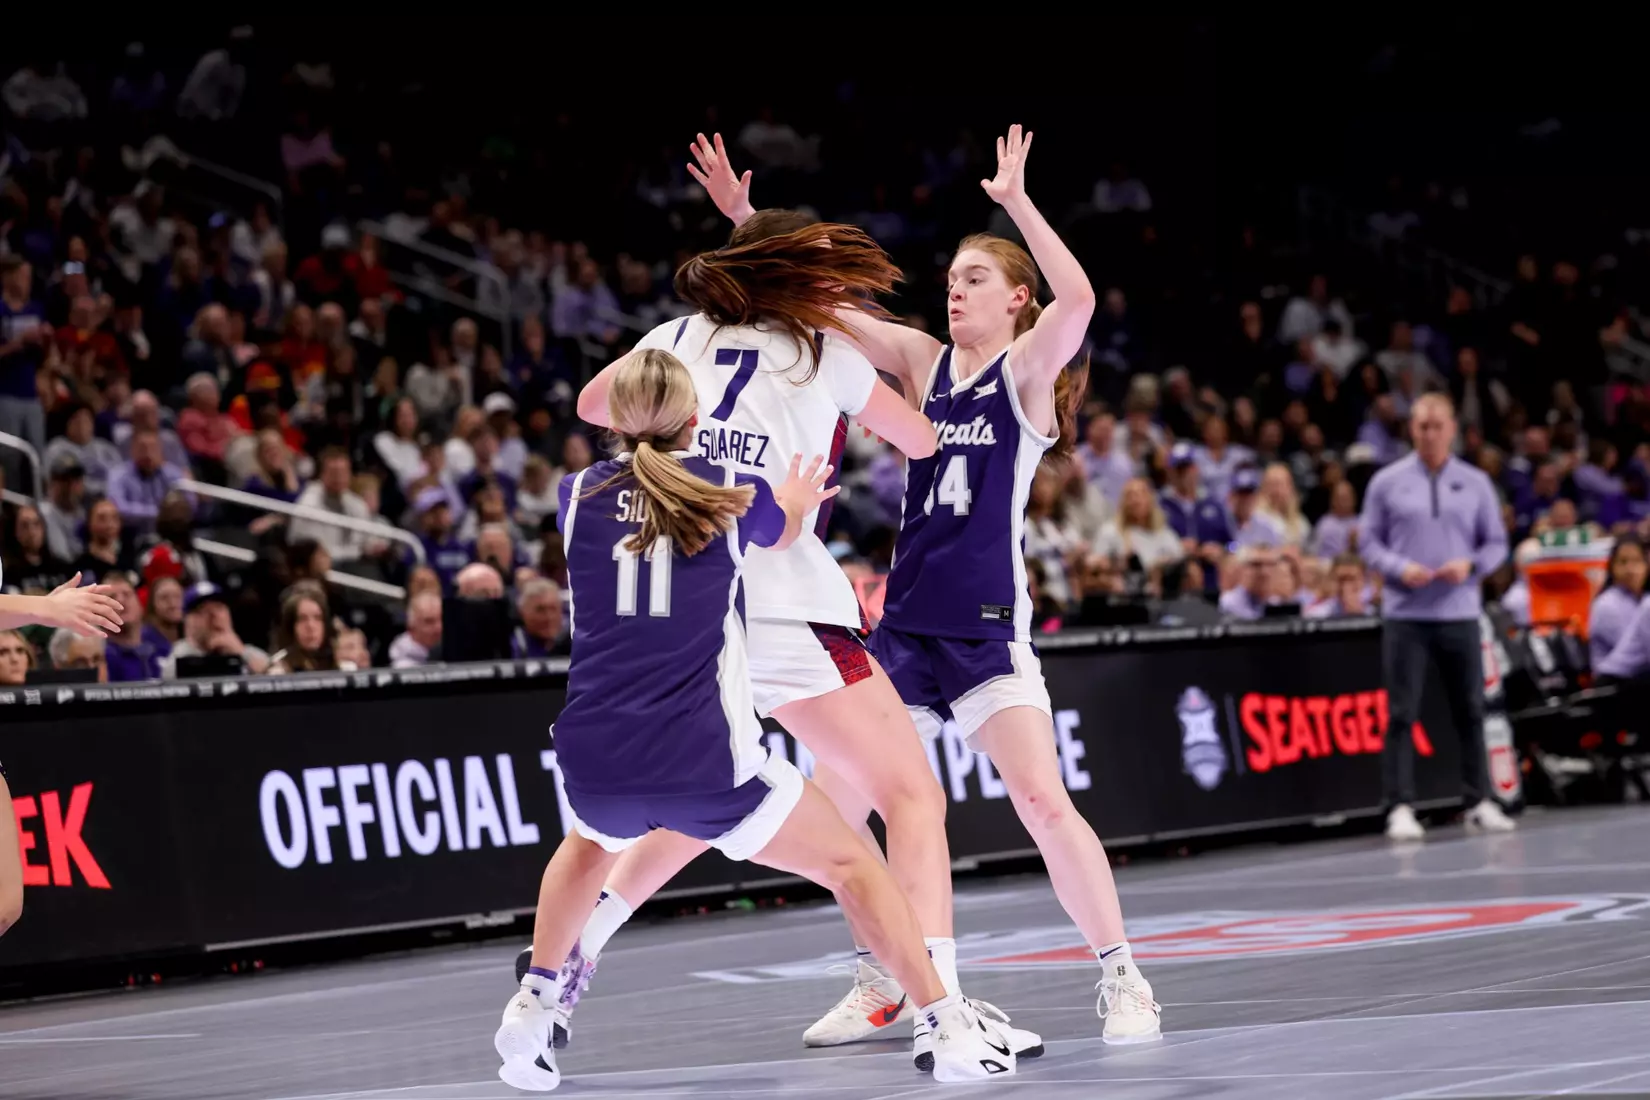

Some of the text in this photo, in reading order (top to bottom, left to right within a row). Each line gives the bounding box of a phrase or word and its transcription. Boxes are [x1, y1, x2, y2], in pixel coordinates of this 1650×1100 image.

[710, 349, 759, 421] 7
[698, 428, 769, 468] SUAREZ
[612, 533, 673, 617] 11
[1240, 688, 1434, 773] SEATGE
[259, 752, 540, 869] OFFICIAL
